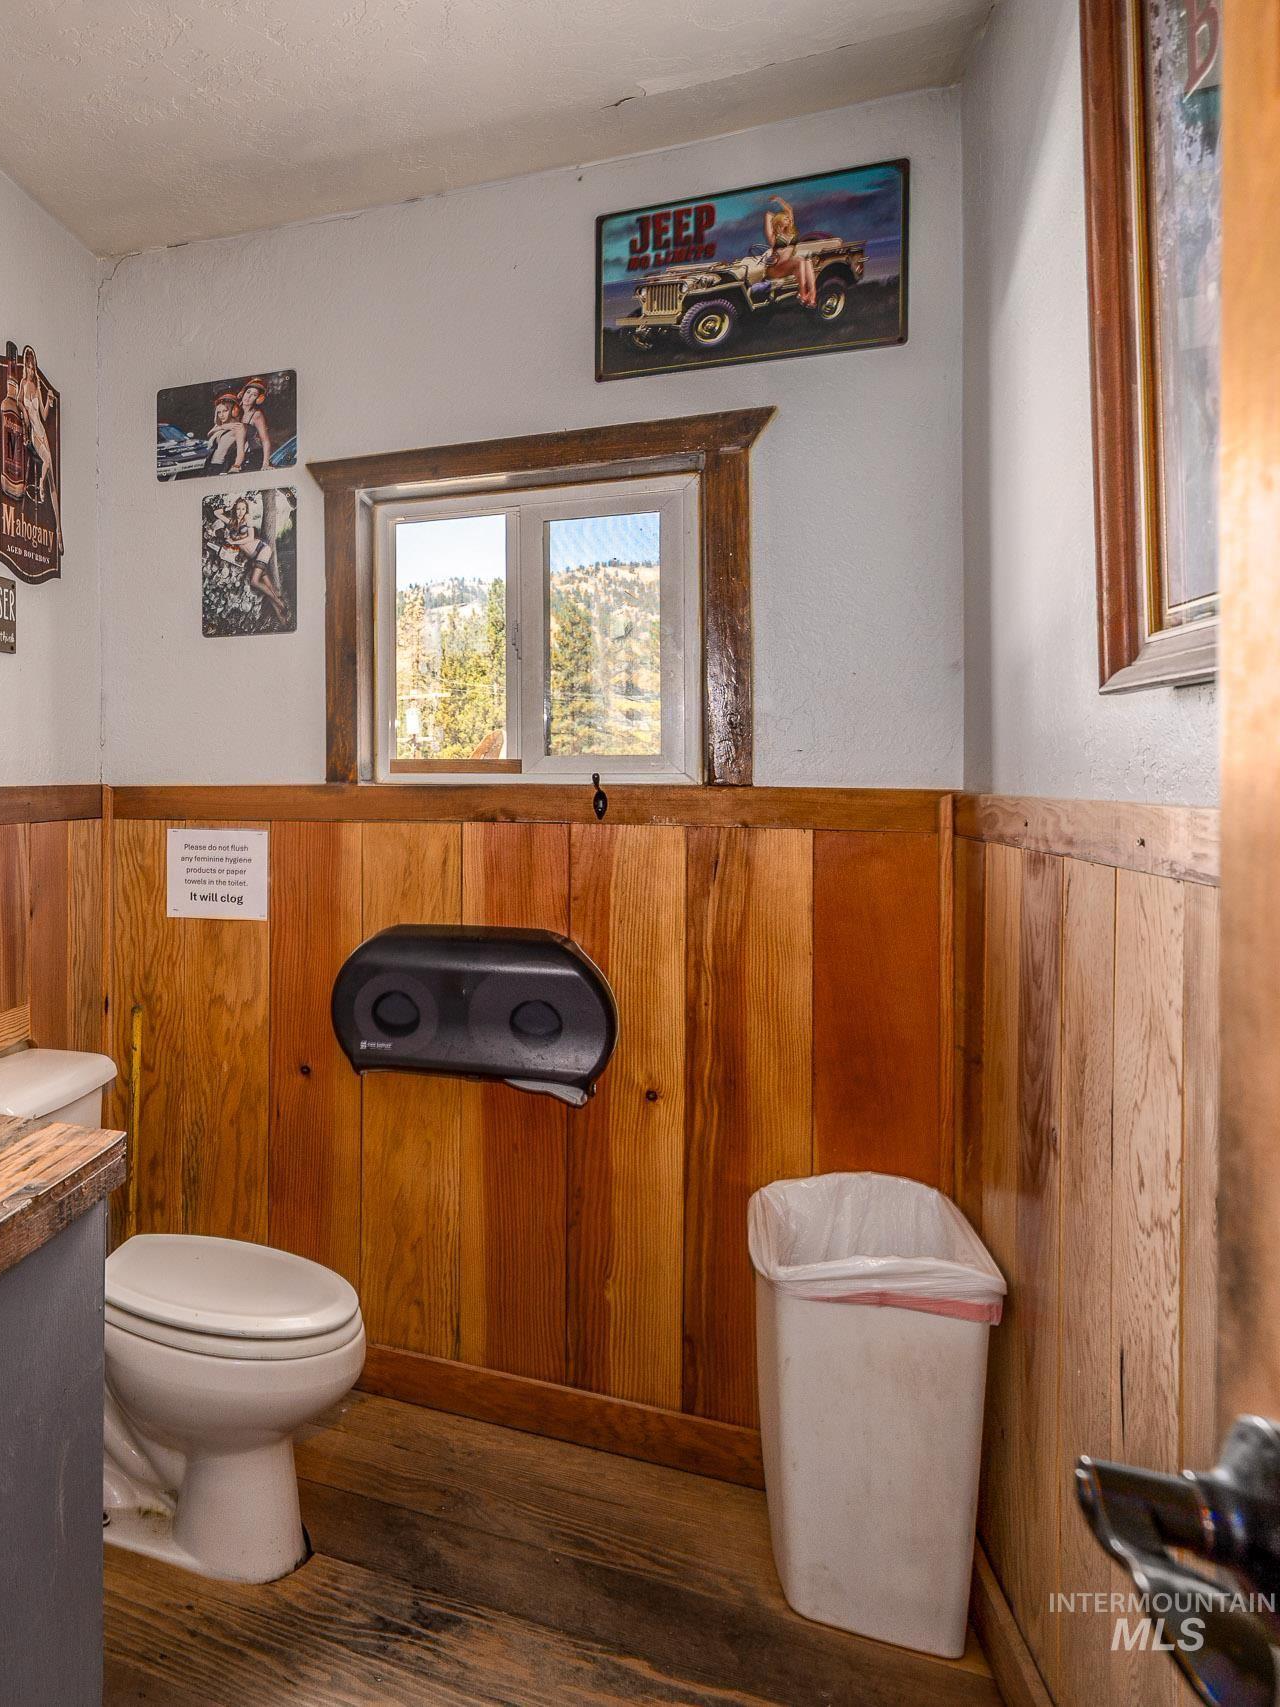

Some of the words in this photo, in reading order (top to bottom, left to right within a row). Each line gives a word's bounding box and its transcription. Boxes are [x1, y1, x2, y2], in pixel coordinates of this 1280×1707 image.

[629, 203, 716, 255] JEEP
[1, 503, 54, 552] Mahogany
[7, 545, 23, 555] AGED
[23, 549, 50, 564] BOURBON
[0, 630, 15, 643] think
[184, 843, 207, 852] Please
[207, 844, 217, 852] do
[218, 844, 230, 852] not
[230, 844, 249, 852] flush
[194, 855, 224, 863] feminine
[224, 856, 252, 865] hygiene
[186, 867, 217, 875] products
[226, 869, 247, 877] paper
[184, 878, 207, 886] towels
[215, 879, 227, 887] the
[227, 879, 249, 887] toilet.
[190, 892, 197, 902] It
[199, 892, 218, 903] will
[220, 893, 244, 906] clog
